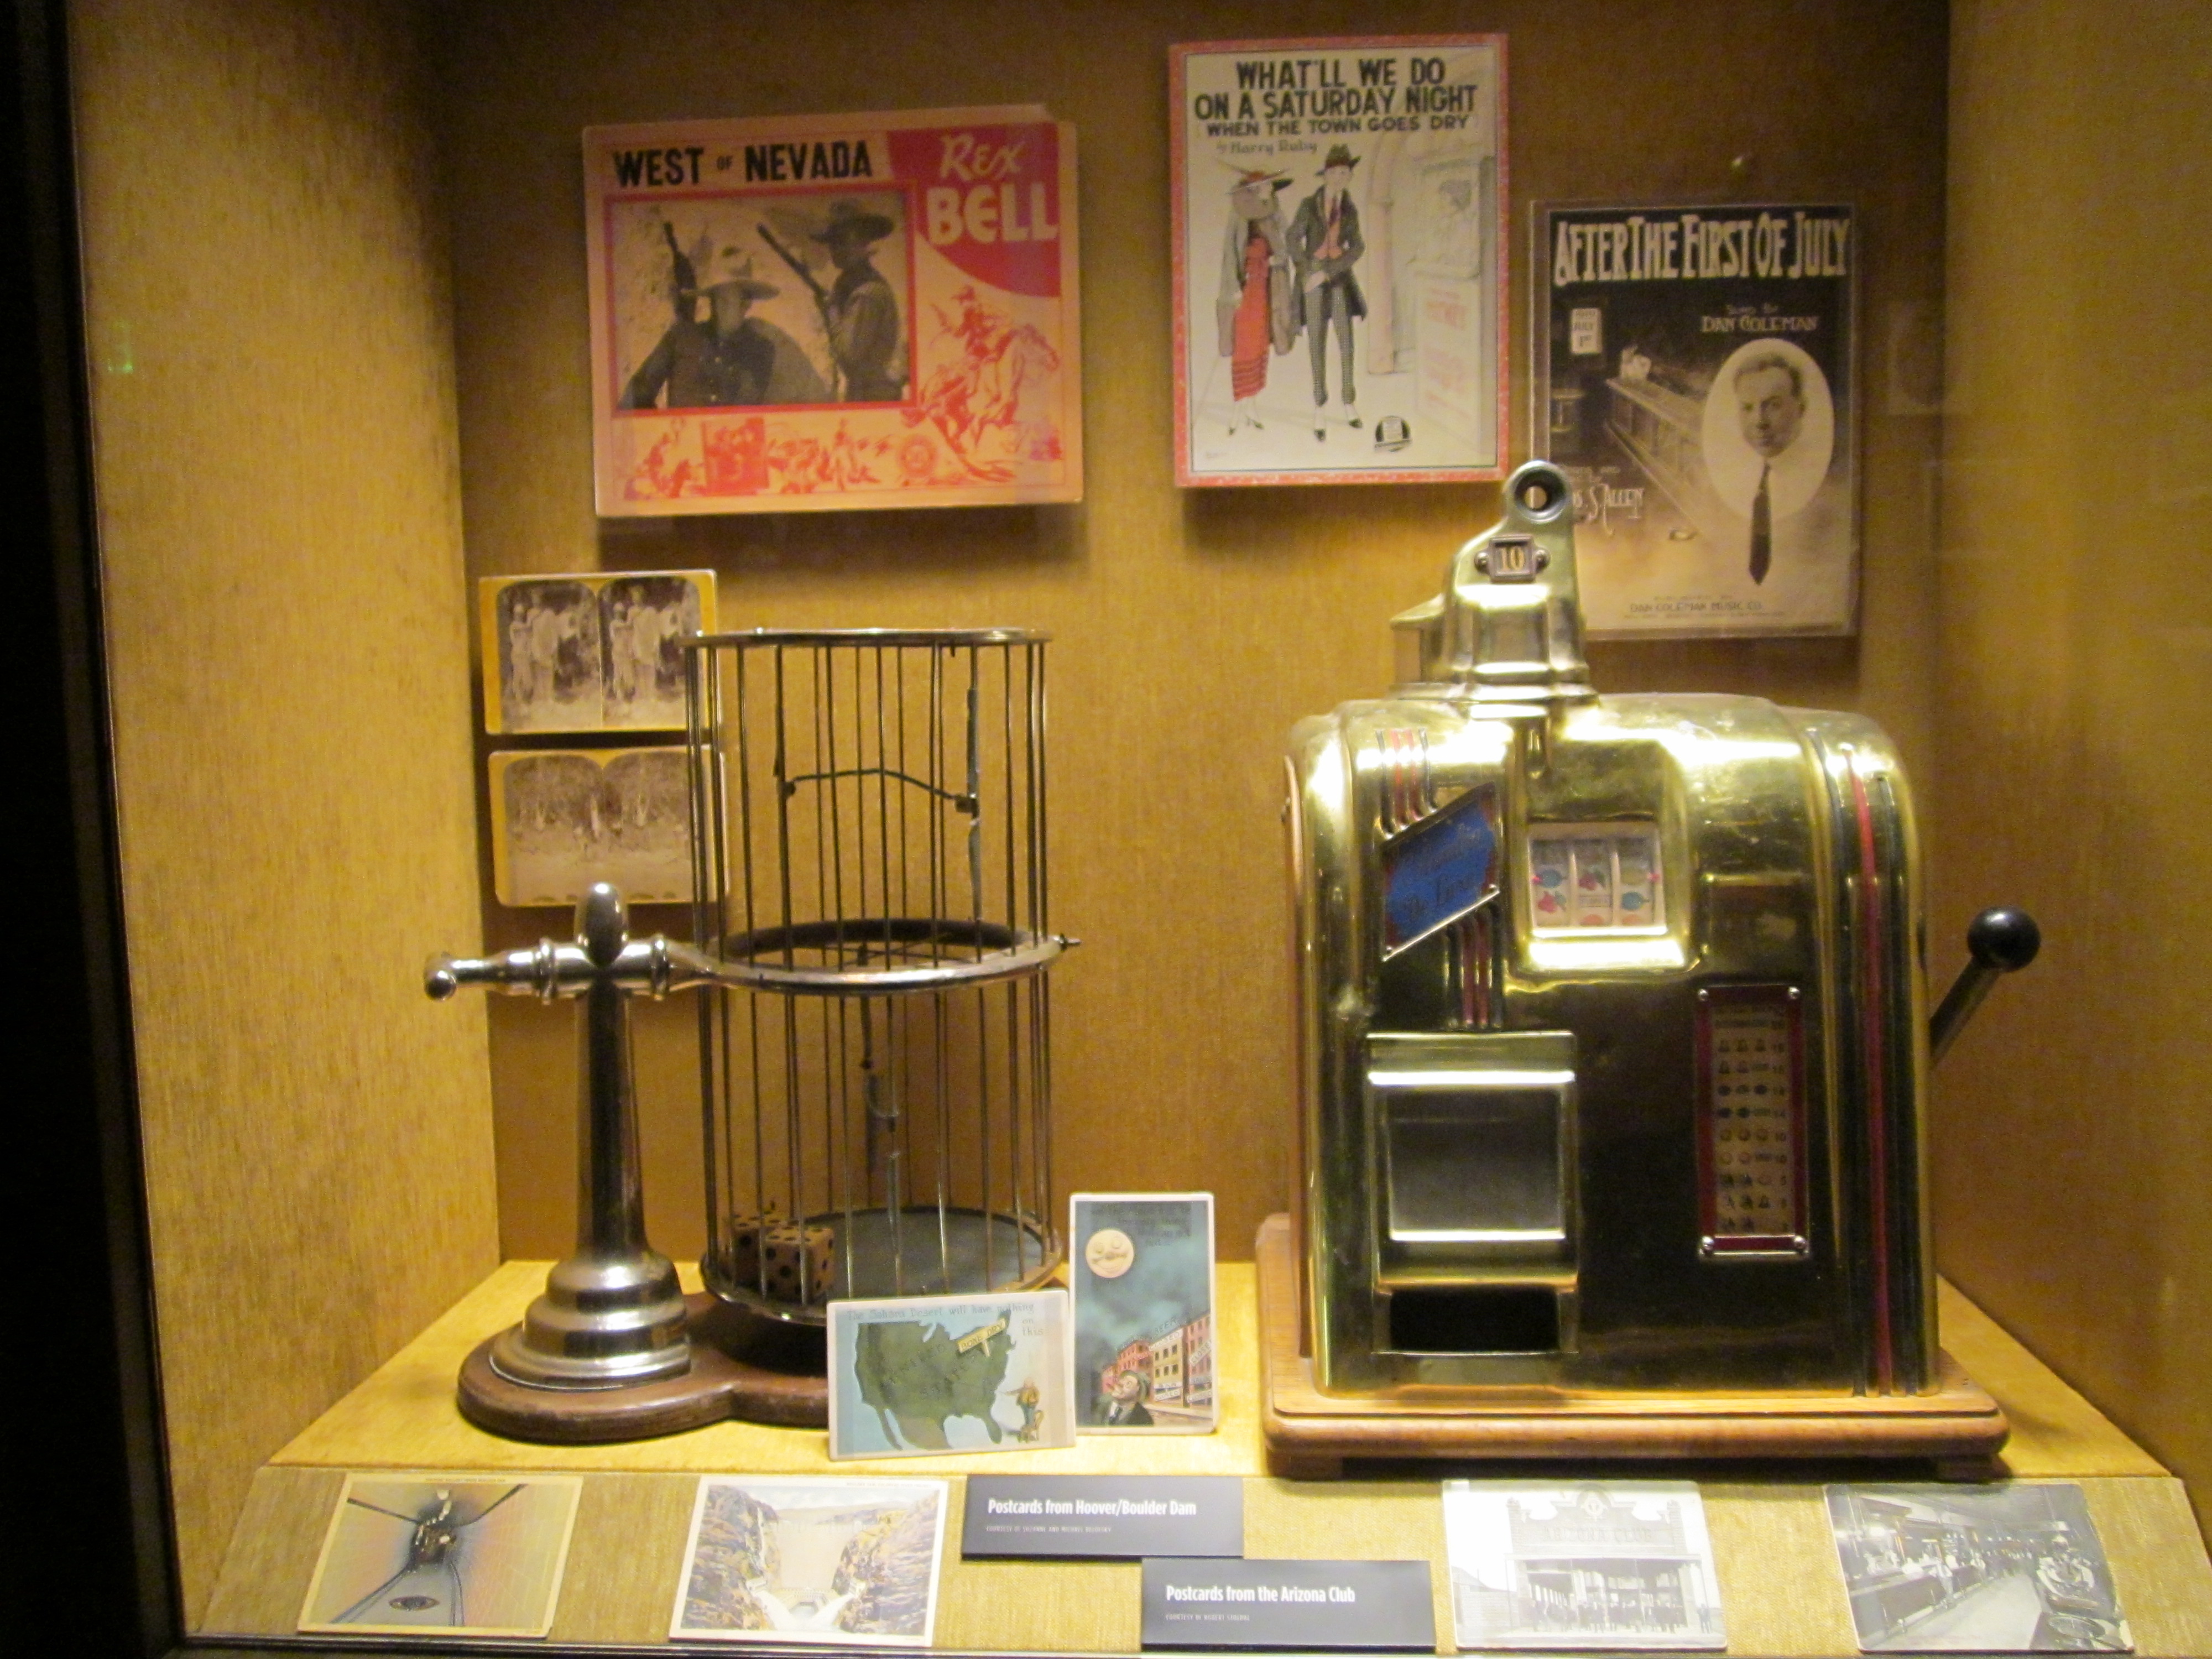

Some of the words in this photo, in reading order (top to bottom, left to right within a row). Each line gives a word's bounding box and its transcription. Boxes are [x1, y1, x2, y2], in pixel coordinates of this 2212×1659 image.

[1236, 59, 1346, 90] WHAT'LL
[1358, 57, 1397, 86] WE
[1411, 56, 1446, 85] DO
[1194, 92, 1229, 120] ON
[1238, 91, 1255, 120] A
[1262, 87, 1396, 119] SATURDAY
[1405, 85, 1478, 112] NIGHT
[1206, 120, 1260, 137] WHEN
[1268, 118, 1302, 135] THE
[1308, 117, 1362, 134] TOWN
[1368, 114, 1420, 132] GOES
[1430, 113, 1469, 130] DRY
[1230, 140, 1274, 155] Harry
[1278, 138, 1318, 154] Ruby
[612, 147, 705, 187] WEST
[717, 154, 733, 171] OF
[745, 139, 873, 182] NEVADA
[927, 181, 1059, 246] BELL
[1554, 221, 1629, 288] AFTER
[1627, 216, 1679, 280] THE
[1681, 213, 1753, 279] FIRST
[1754, 212, 1787, 278] OF
[1787, 211, 1850, 279] JULY
[1700, 315, 1735, 332] DAN
[1739, 314, 1819, 332] COLEMAN
[1500, 547, 1525, 571] 10
[870, 1308, 905, 1319] Sahara
[910, 1307, 943, 1318] Desert
[949, 1305, 967, 1315] will
[972, 1303, 992, 1314] have
[997, 1302, 1034, 1316] nothing
[1022, 1326, 1044, 1337] this
[988, 1498, 1043, 1515] Postcards
[1046, 1499, 1073, 1515] from
[1076, 1499, 1167, 1517] Hoover/Boulder
[1170, 1499, 1197, 1516] Dam
[1166, 1585, 1224, 1603] Postcards
[1226, 1586, 1256, 1603] from
[1258, 1587, 1279, 1603] the
[1281, 1586, 1327, 1603] Arizona
[1329, 1587, 1356, 1603] Club
